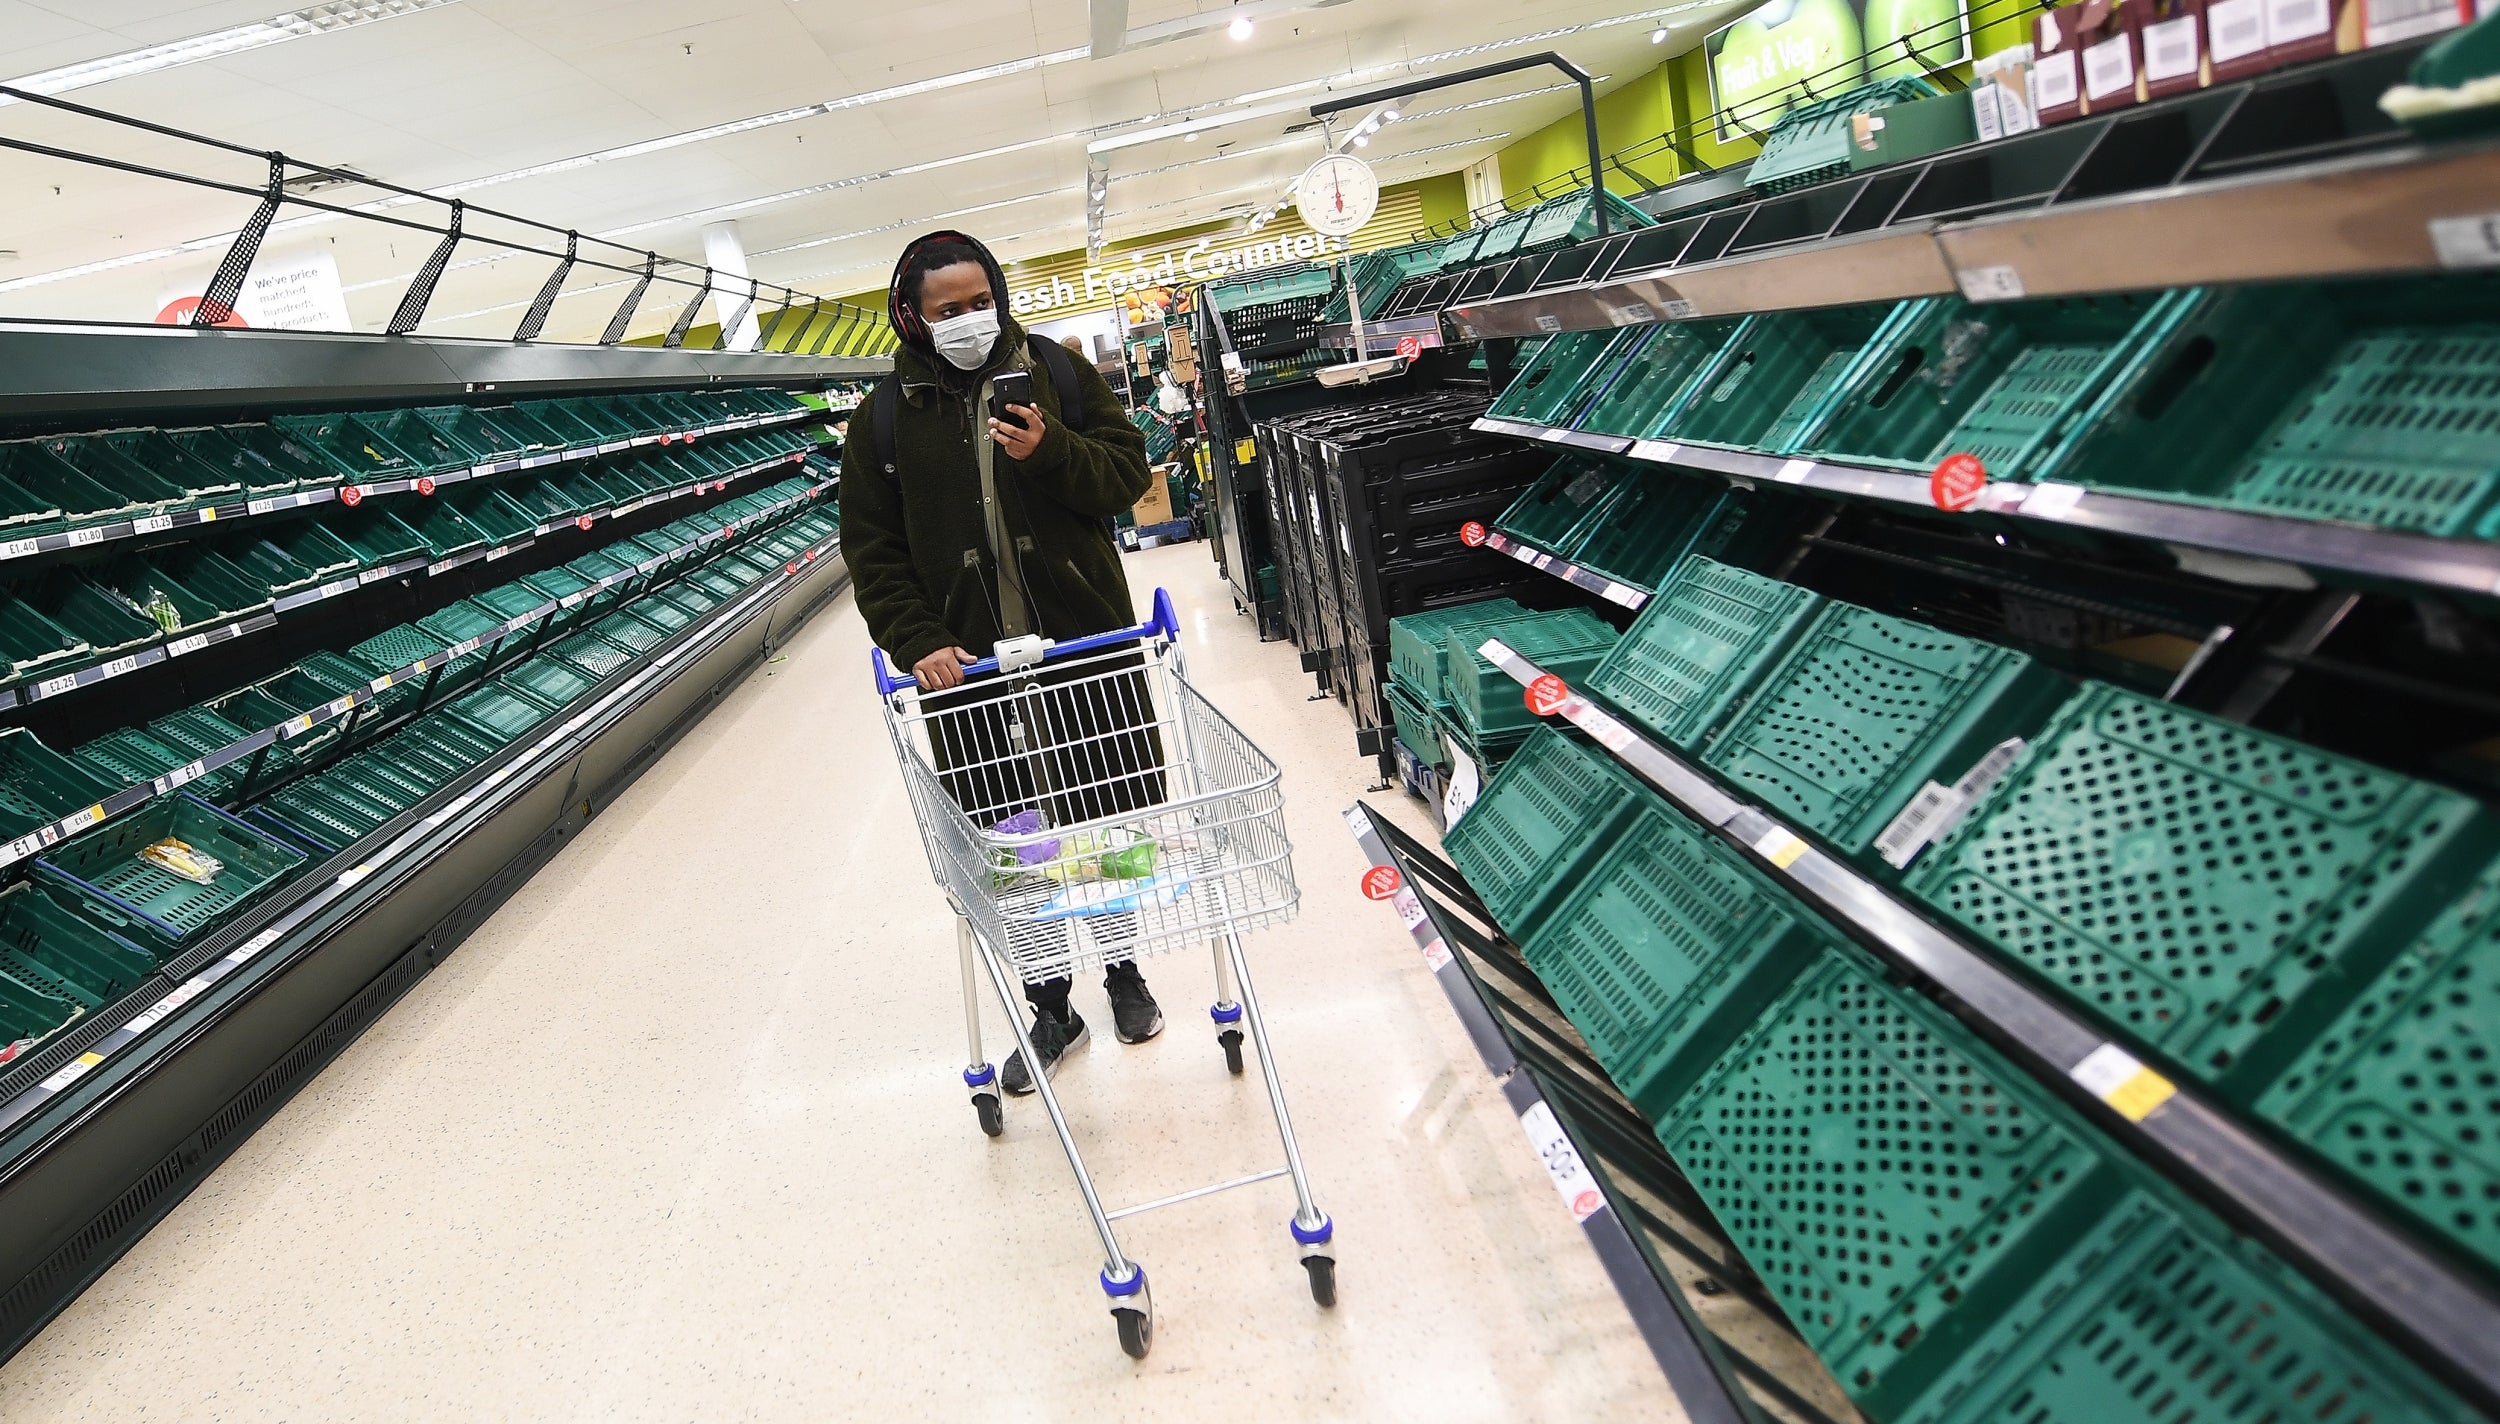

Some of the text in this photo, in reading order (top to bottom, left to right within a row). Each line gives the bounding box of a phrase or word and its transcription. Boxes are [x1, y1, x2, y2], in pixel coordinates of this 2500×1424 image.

[1720, 35, 1816, 96] Fruit & Veg
[254, 269, 318, 289] We've price
[1011, 233, 1342, 314] esh Food Counters
[260, 286, 306, 303] matched
[264, 300, 313, 318] hundreds
[281, 312, 329, 329] products
[150, 518, 171, 529] £1.25
[78, 530, 102, 543] £1.80
[9, 540, 36, 555] £1.40
[366, 569, 378, 581] 57p
[185, 636, 205, 650] £1.20
[112, 658, 135, 674] £1.10
[49, 676, 75, 692] £2.25
[185, 764, 199, 780] £1
[74, 812, 93, 826] £1.65
[13, 839, 31, 857] £1
[239, 937, 268, 956] £1.20
[141, 1004, 169, 1021] 77p
[59, 1062, 85, 1081] £1.70
[1542, 1137, 1575, 1179] 50p
